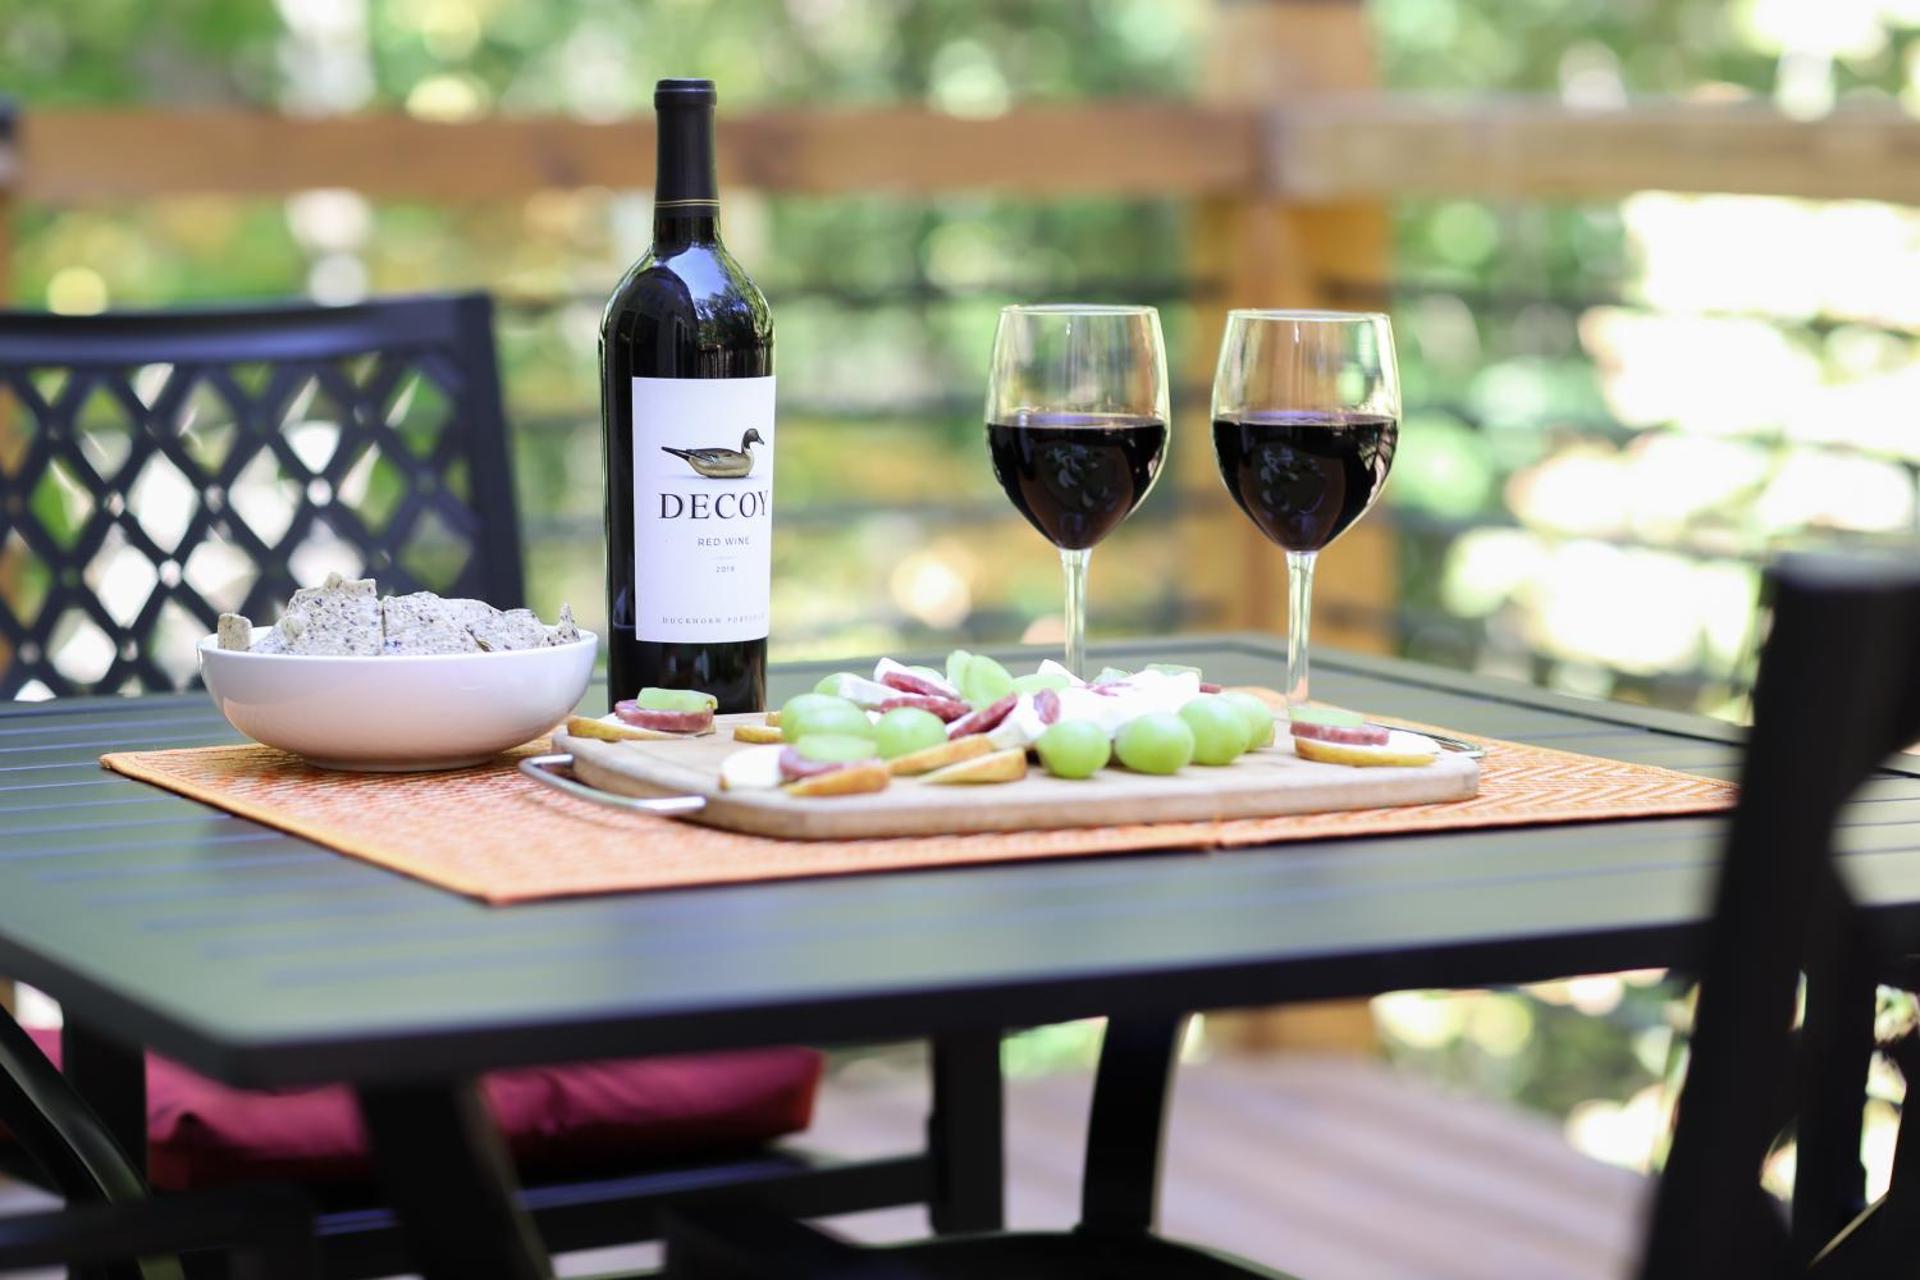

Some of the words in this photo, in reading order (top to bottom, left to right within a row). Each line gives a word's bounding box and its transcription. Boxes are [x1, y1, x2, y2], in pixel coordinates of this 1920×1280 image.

[658, 490, 769, 519] DECOY
[697, 537, 721, 547] RED
[724, 536, 750, 546] WINE
